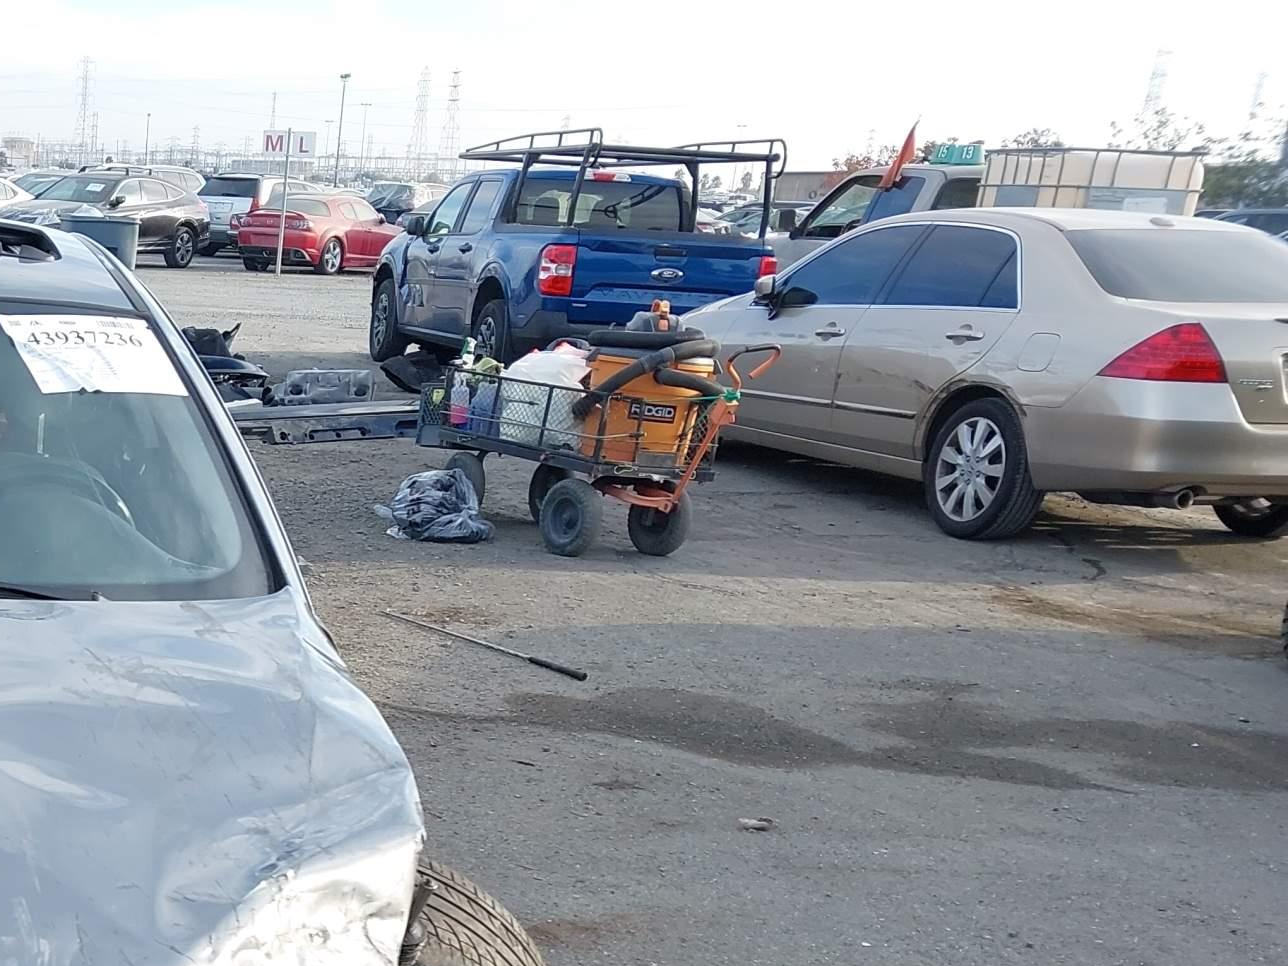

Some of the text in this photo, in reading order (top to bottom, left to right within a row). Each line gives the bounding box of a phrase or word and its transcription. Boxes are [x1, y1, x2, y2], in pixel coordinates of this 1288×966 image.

[266, 135, 283, 152] M
[299, 136, 309, 153] L
[962, 145, 975, 159] 13
[27, 330, 143, 348] 43937236
[631, 403, 675, 418] RDGID
